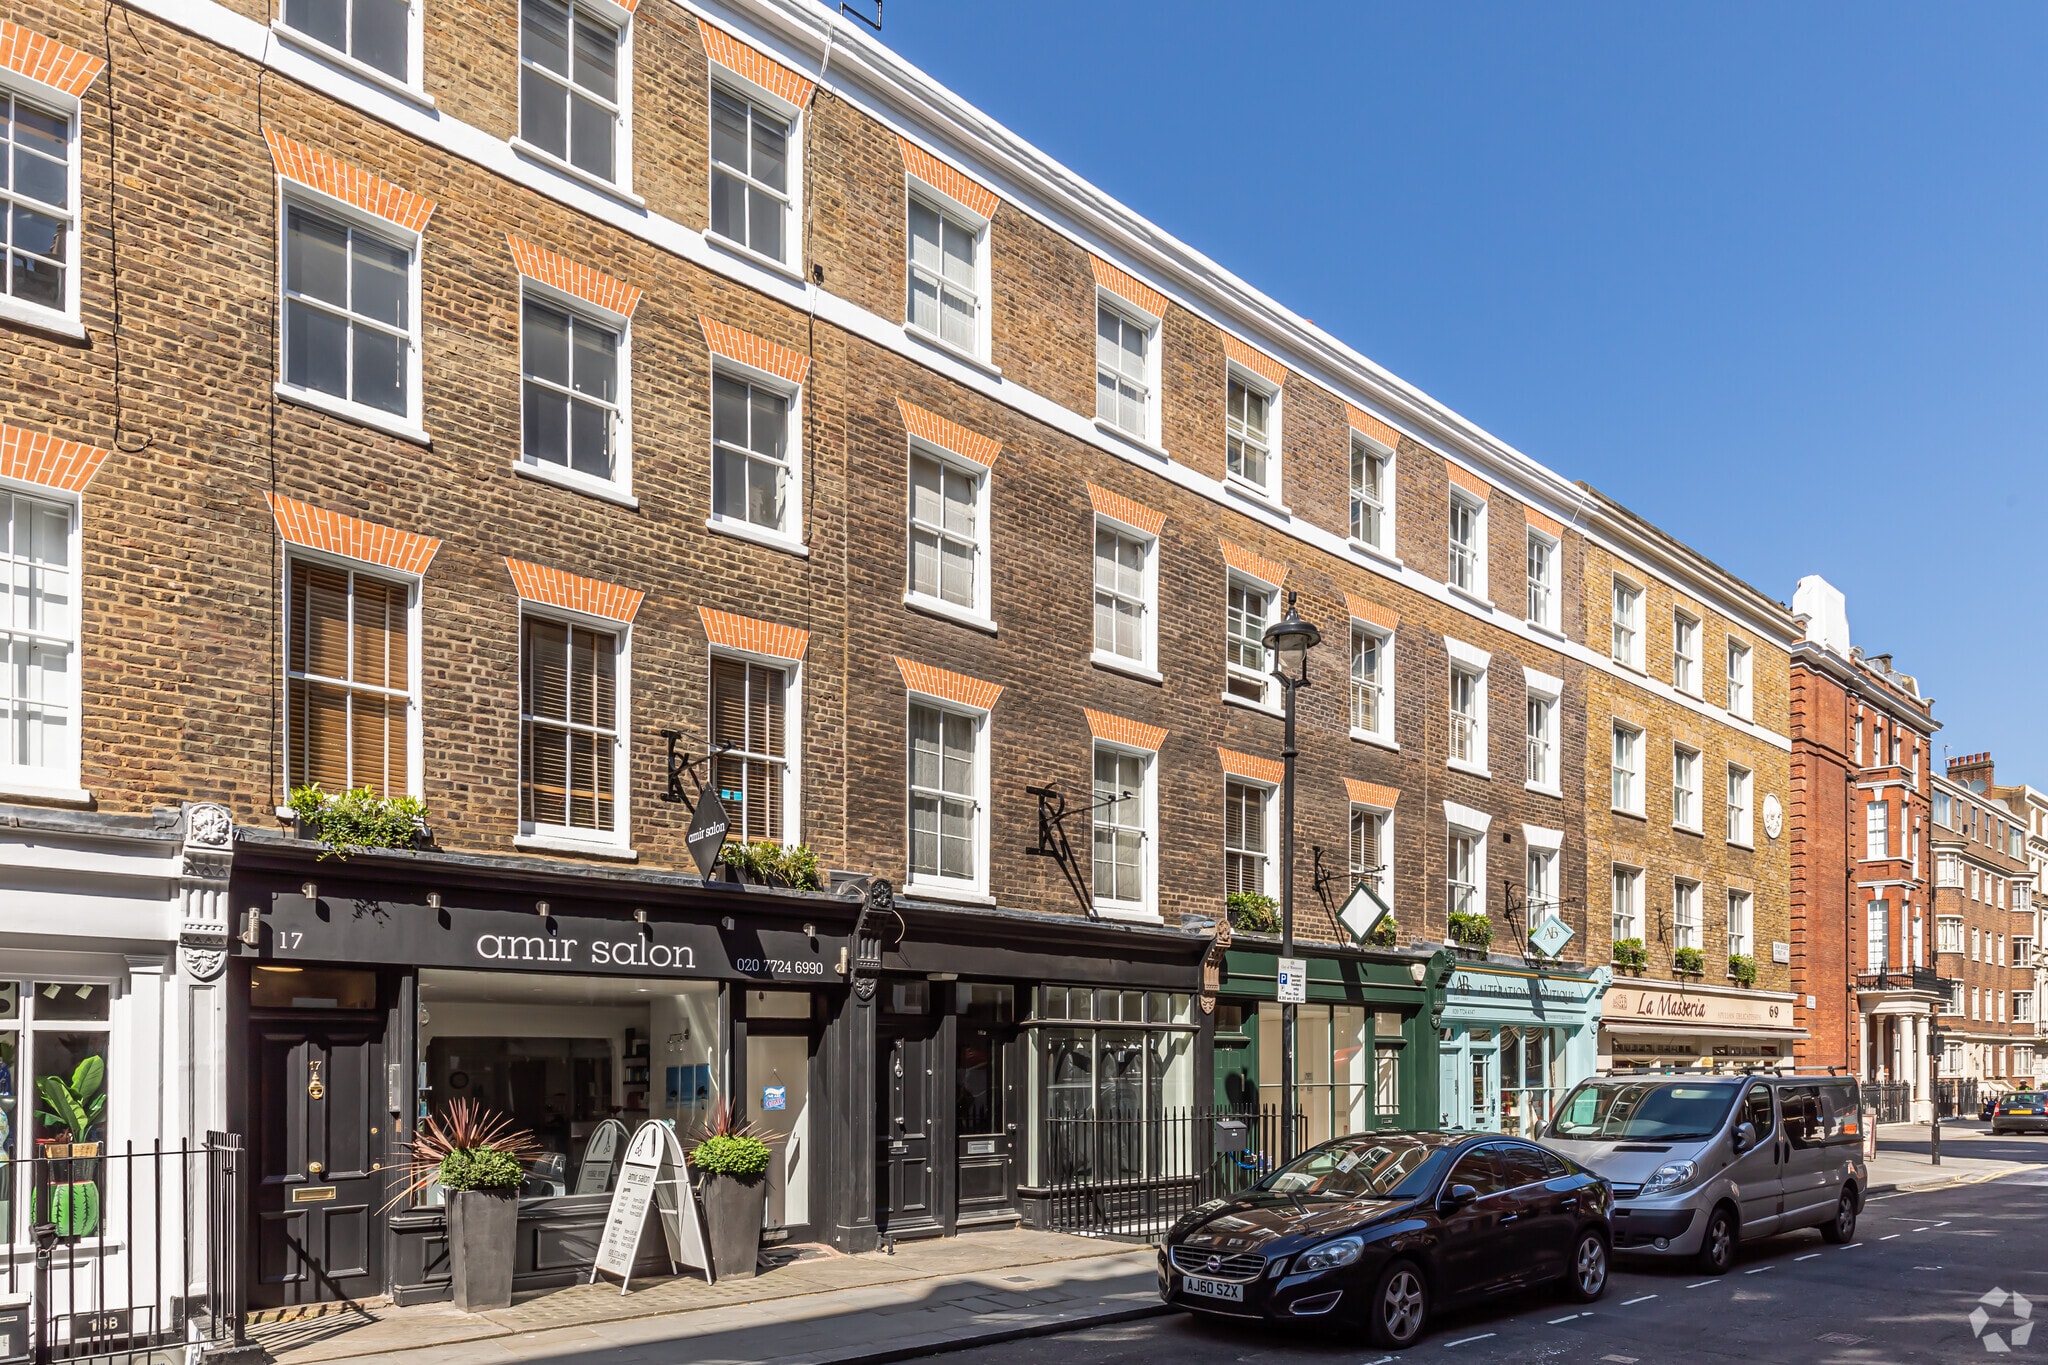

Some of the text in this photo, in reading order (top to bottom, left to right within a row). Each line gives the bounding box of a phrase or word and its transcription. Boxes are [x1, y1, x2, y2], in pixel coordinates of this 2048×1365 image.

[688, 821, 725, 843] amir salon
[279, 931, 303, 949] 17
[1543, 926, 1559, 941] AB
[476, 929, 696, 969] amir salon
[737, 958, 824, 975] 020 7724 6990
[1281, 974, 1286, 983] P
[1636, 993, 1706, 1018] La Masseria
[1768, 1005, 1779, 1019] 69
[309, 1060, 322, 1070] 17
[1187, 1278, 1238, 1298] AJ60 SZX
